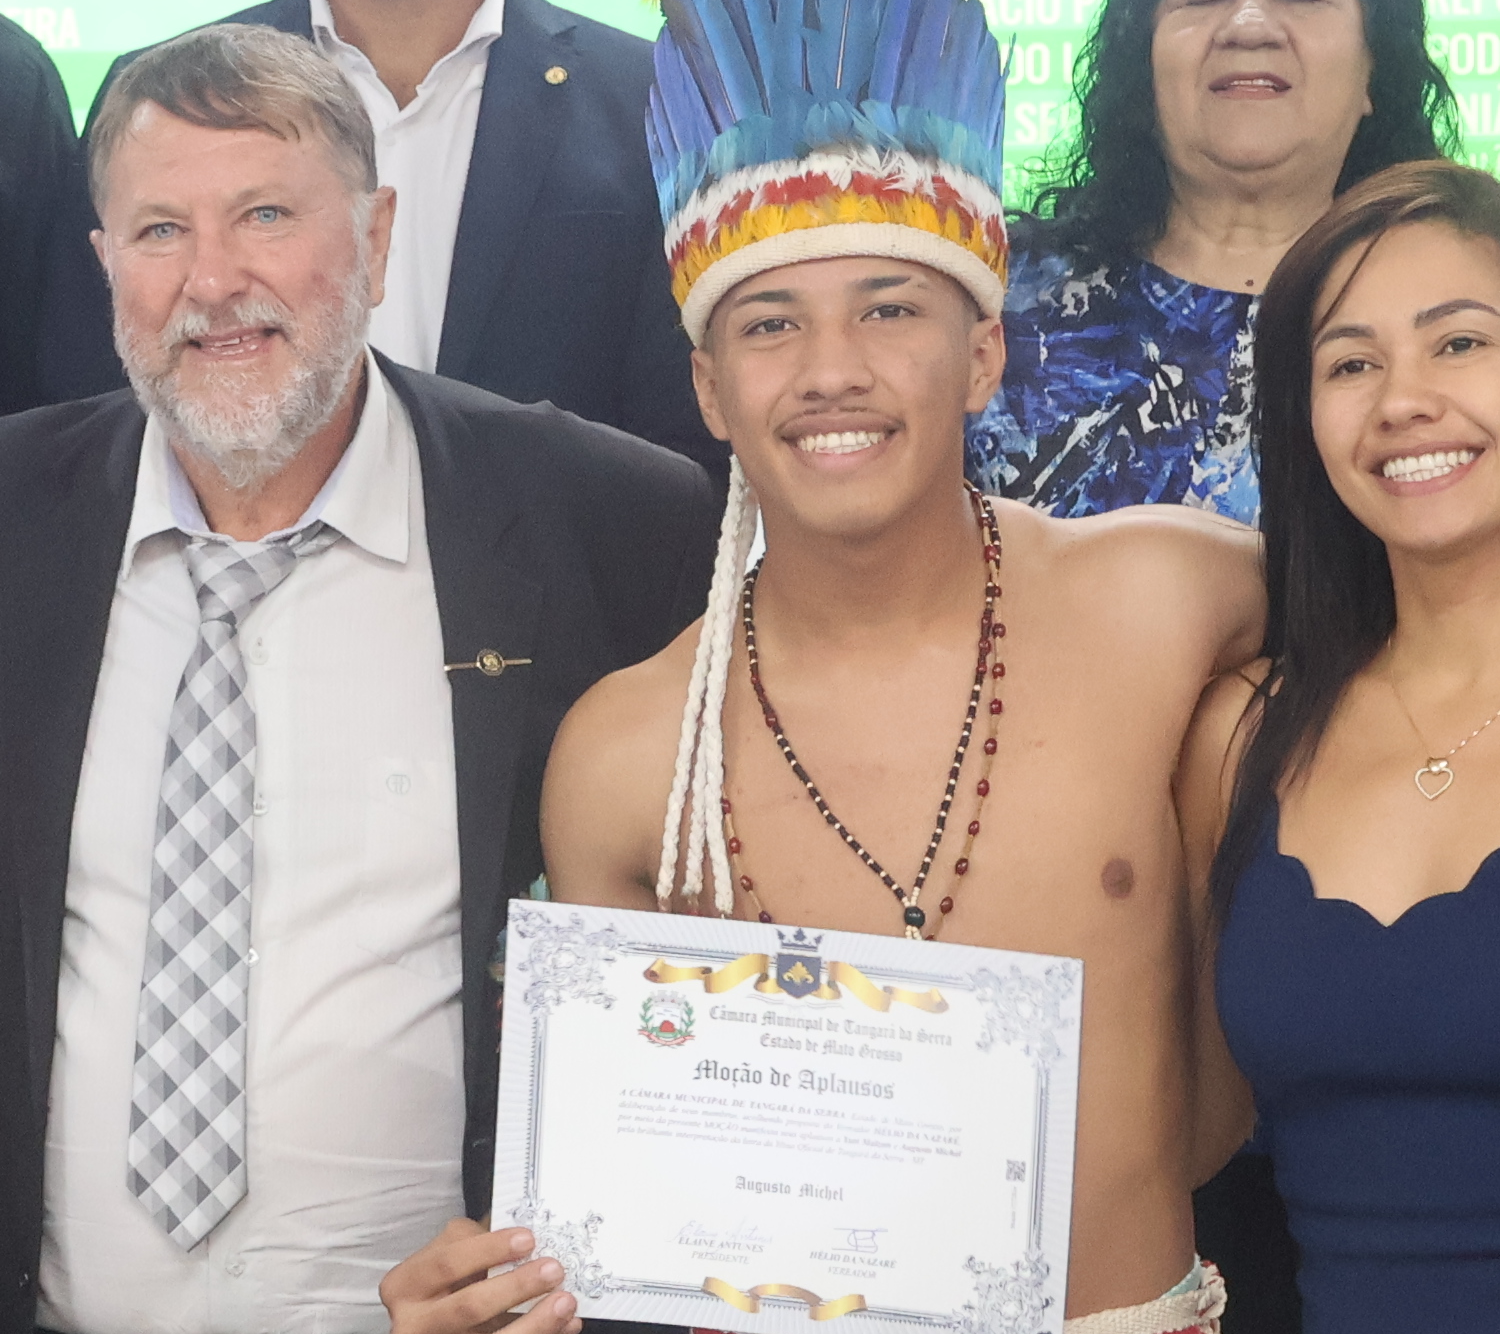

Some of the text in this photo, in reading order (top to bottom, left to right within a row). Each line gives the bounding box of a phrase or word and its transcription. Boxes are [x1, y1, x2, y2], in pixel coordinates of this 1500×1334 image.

[709, 1005, 757, 1024] Câmara
[762, 1011, 823, 1031] Municipal
[826, 1018, 840, 1033] de
[844, 1019, 895, 1040] Tangará
[899, 1027, 912, 1042] da
[760, 1033, 802, 1051] Estado
[805, 1038, 818, 1053] de
[692, 1058, 895, 1101] Moção de Aplausos
[735, 1175, 844, 1202] Augusto Michel
